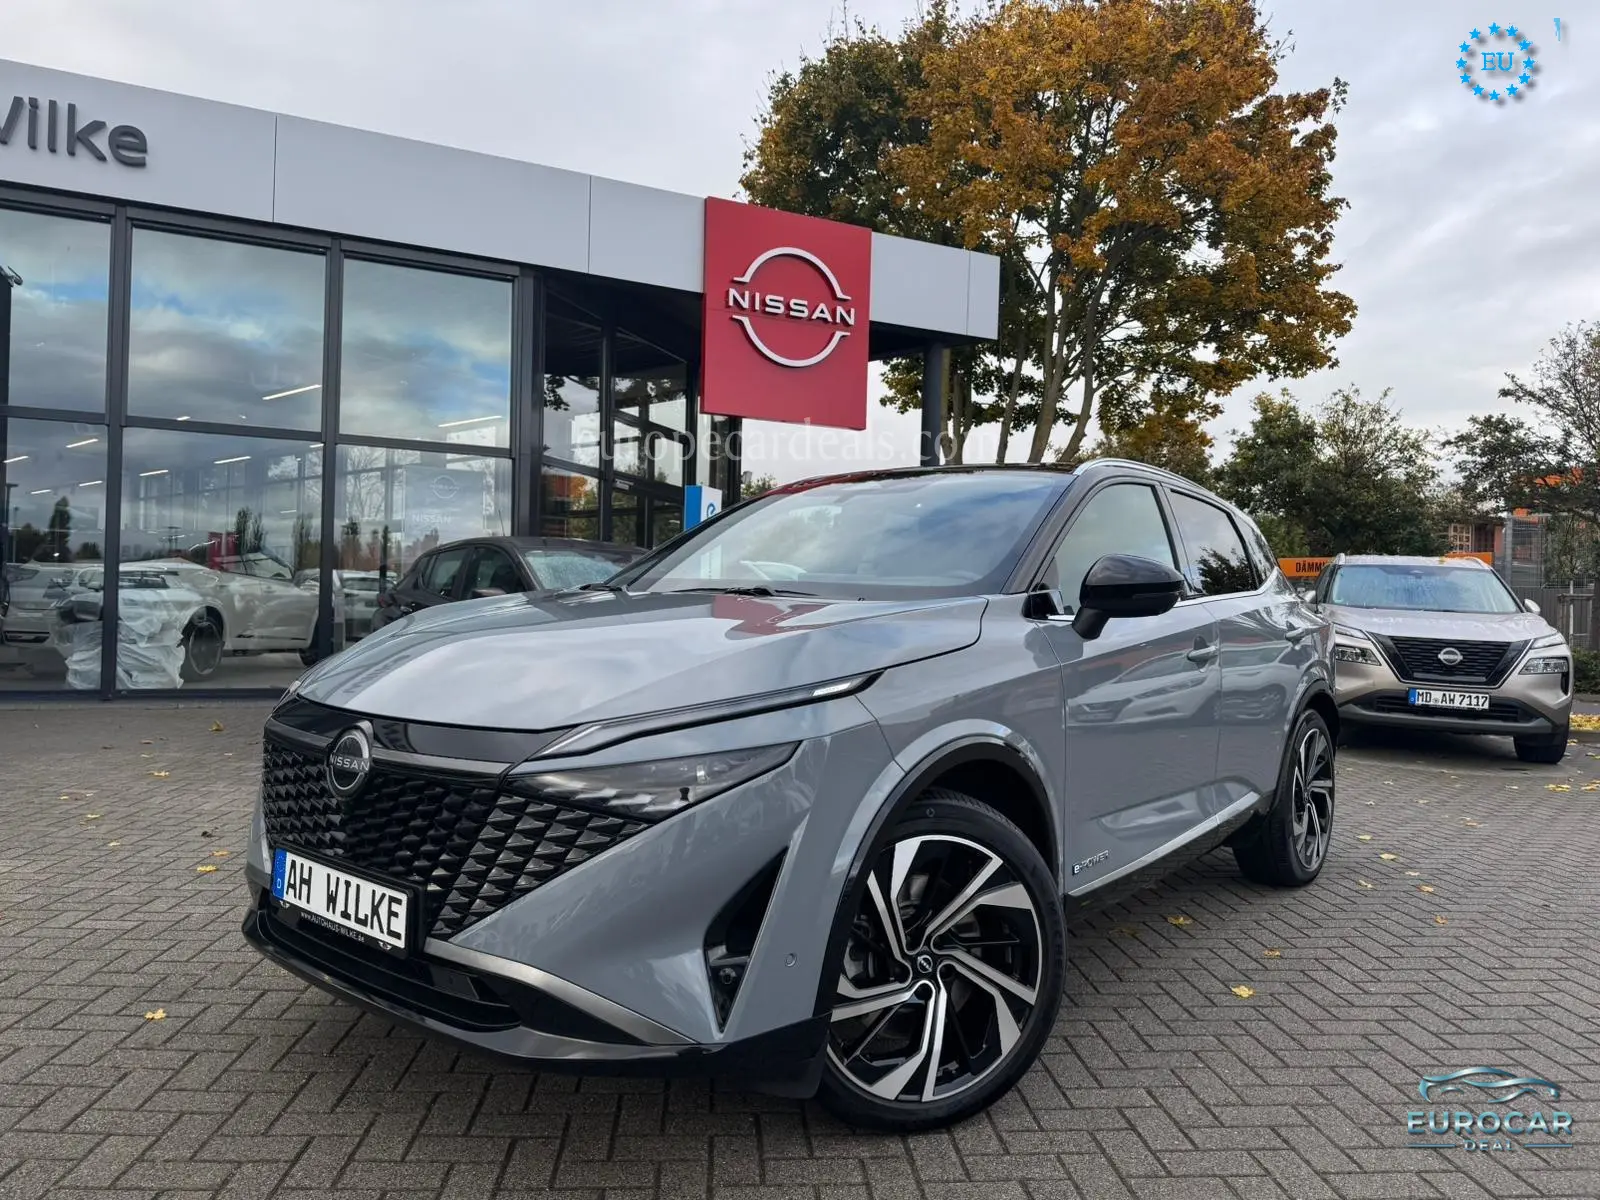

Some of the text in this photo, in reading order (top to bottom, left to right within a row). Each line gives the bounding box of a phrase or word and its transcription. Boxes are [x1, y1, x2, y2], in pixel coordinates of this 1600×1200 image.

[727, 287, 856, 327] NISSAN
[1295, 560, 1326, 573] DÄMM
[1417, 691, 1432, 703] MD
[1458, 694, 1488, 708] 7117
[329, 753, 370, 772] NISSAN
[286, 859, 403, 941] AH WILKE
